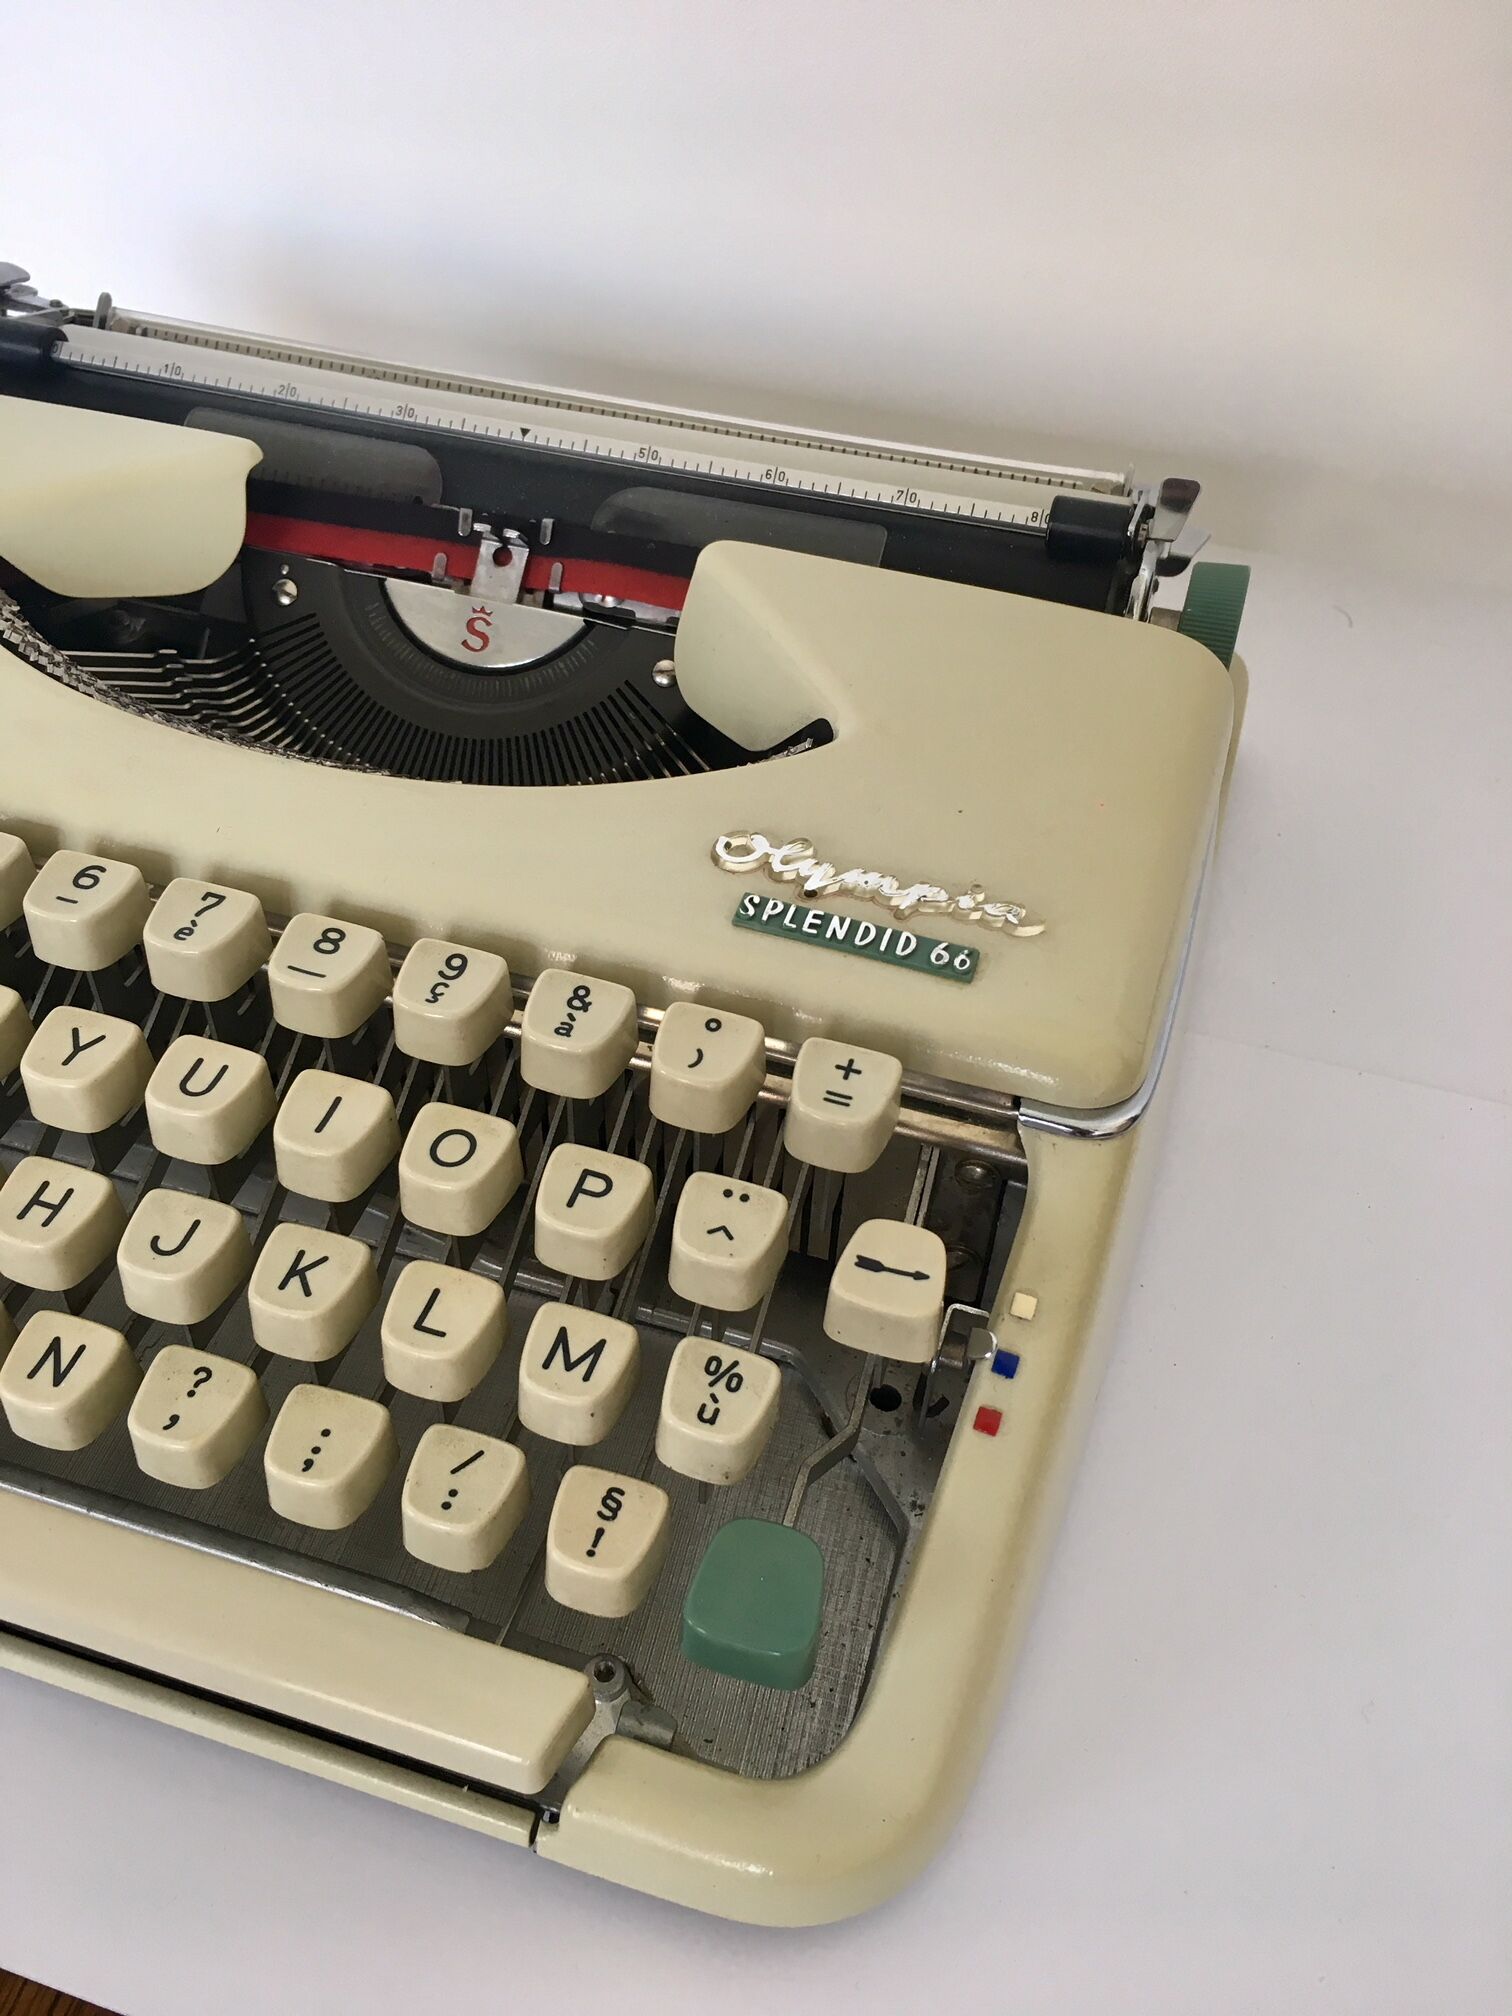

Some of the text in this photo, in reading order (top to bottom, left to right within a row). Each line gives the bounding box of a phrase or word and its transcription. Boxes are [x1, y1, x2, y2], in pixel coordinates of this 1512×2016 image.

[164, 362, 182, 377] 10
[278, 382, 298, 397] 20
[396, 403, 416, 418] 30
[639, 445, 659, 462] 50
[765, 467, 786, 483] 60
[896, 489, 917, 505] 70
[73, 865, 106, 889] 6
[711, 830, 1046, 937] Olympia
[195, 892, 226, 917] 7
[174, 920, 197, 940] è
[313, 928, 346, 954] 8
[739, 895, 972, 971] SPLENDID 66
[438, 953, 468, 980] 9
[425, 982, 449, 1003] ç
[567, 985, 592, 1012] &
[554, 1013, 576, 1037] à
[62, 1027, 106, 1066] Y
[179, 1058, 228, 1097] U
[835, 1059, 862, 1080] +
[315, 1096, 342, 1133] I
[823, 1090, 853, 1107] =
[430, 1129, 477, 1167] O
[17, 1181, 74, 1227] H
[566, 1169, 613, 1208] P
[150, 1219, 201, 1256] J
[278, 1250, 329, 1297] K
[413, 1288, 446, 1337] L
[27, 1336, 86, 1387] N
[542, 1327, 606, 1382] M
[187, 1367, 212, 1397] ?
[704, 1356, 743, 1392] %
[697, 1393, 720, 1425] ù
[597, 1487, 625, 1521] §
[586, 1527, 605, 1557] !
